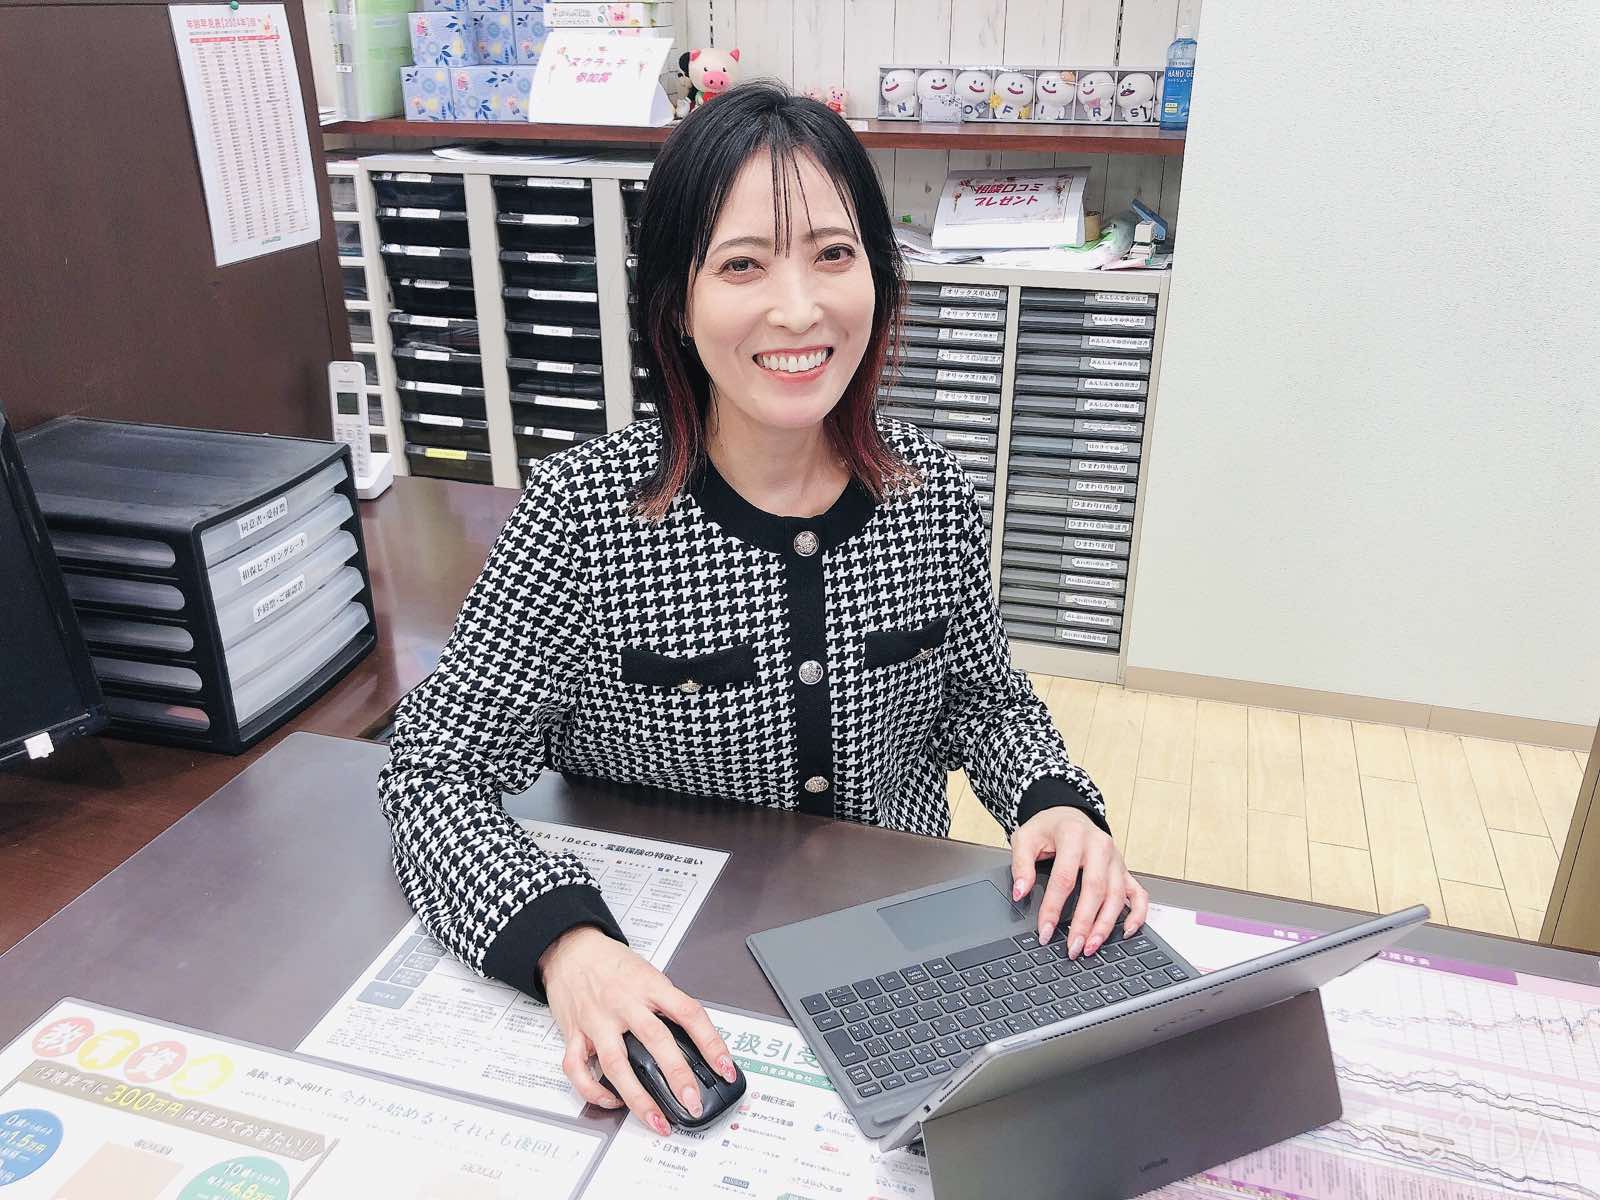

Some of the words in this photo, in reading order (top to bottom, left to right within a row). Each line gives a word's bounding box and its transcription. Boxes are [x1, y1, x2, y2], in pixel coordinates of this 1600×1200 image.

[1167, 69, 1185, 78] HAND
[897, 102, 907, 113] N
[1002, 105, 1013, 114] F
[1092, 107, 1101, 117] R
[1130, 108, 1139, 117] S
[975, 195, 1038, 207] プレゼント
